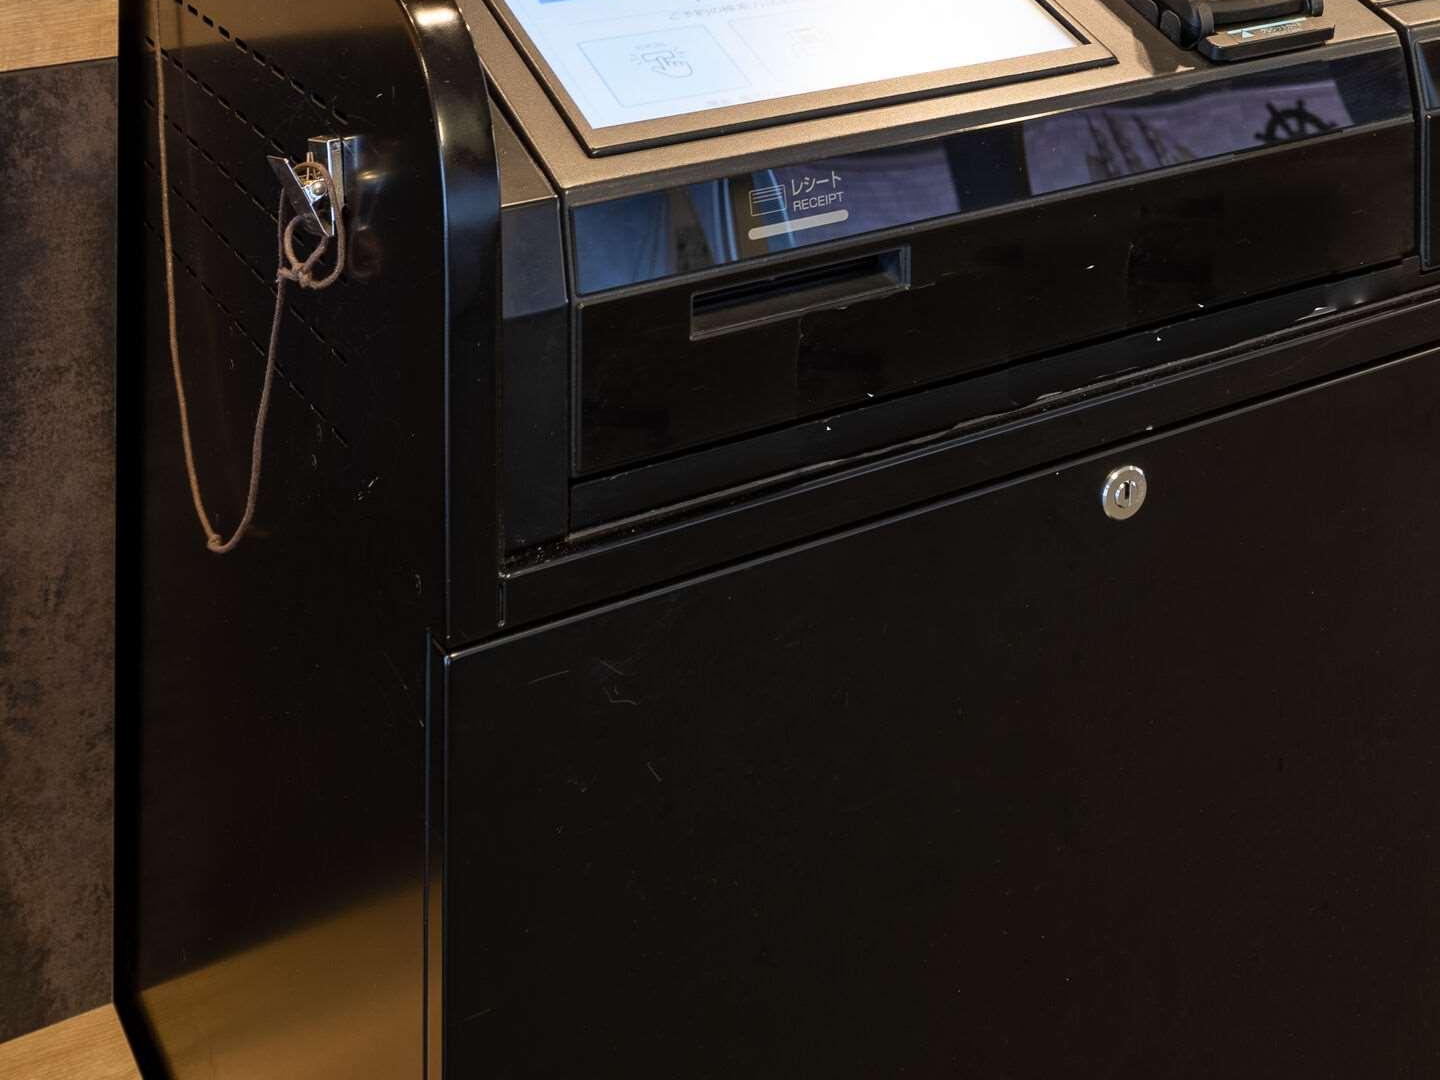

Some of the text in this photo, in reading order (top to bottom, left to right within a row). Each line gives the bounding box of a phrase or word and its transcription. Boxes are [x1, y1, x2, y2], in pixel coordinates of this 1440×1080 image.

[791, 170, 843, 196] レシート
[793, 191, 845, 213] RECEIPT
